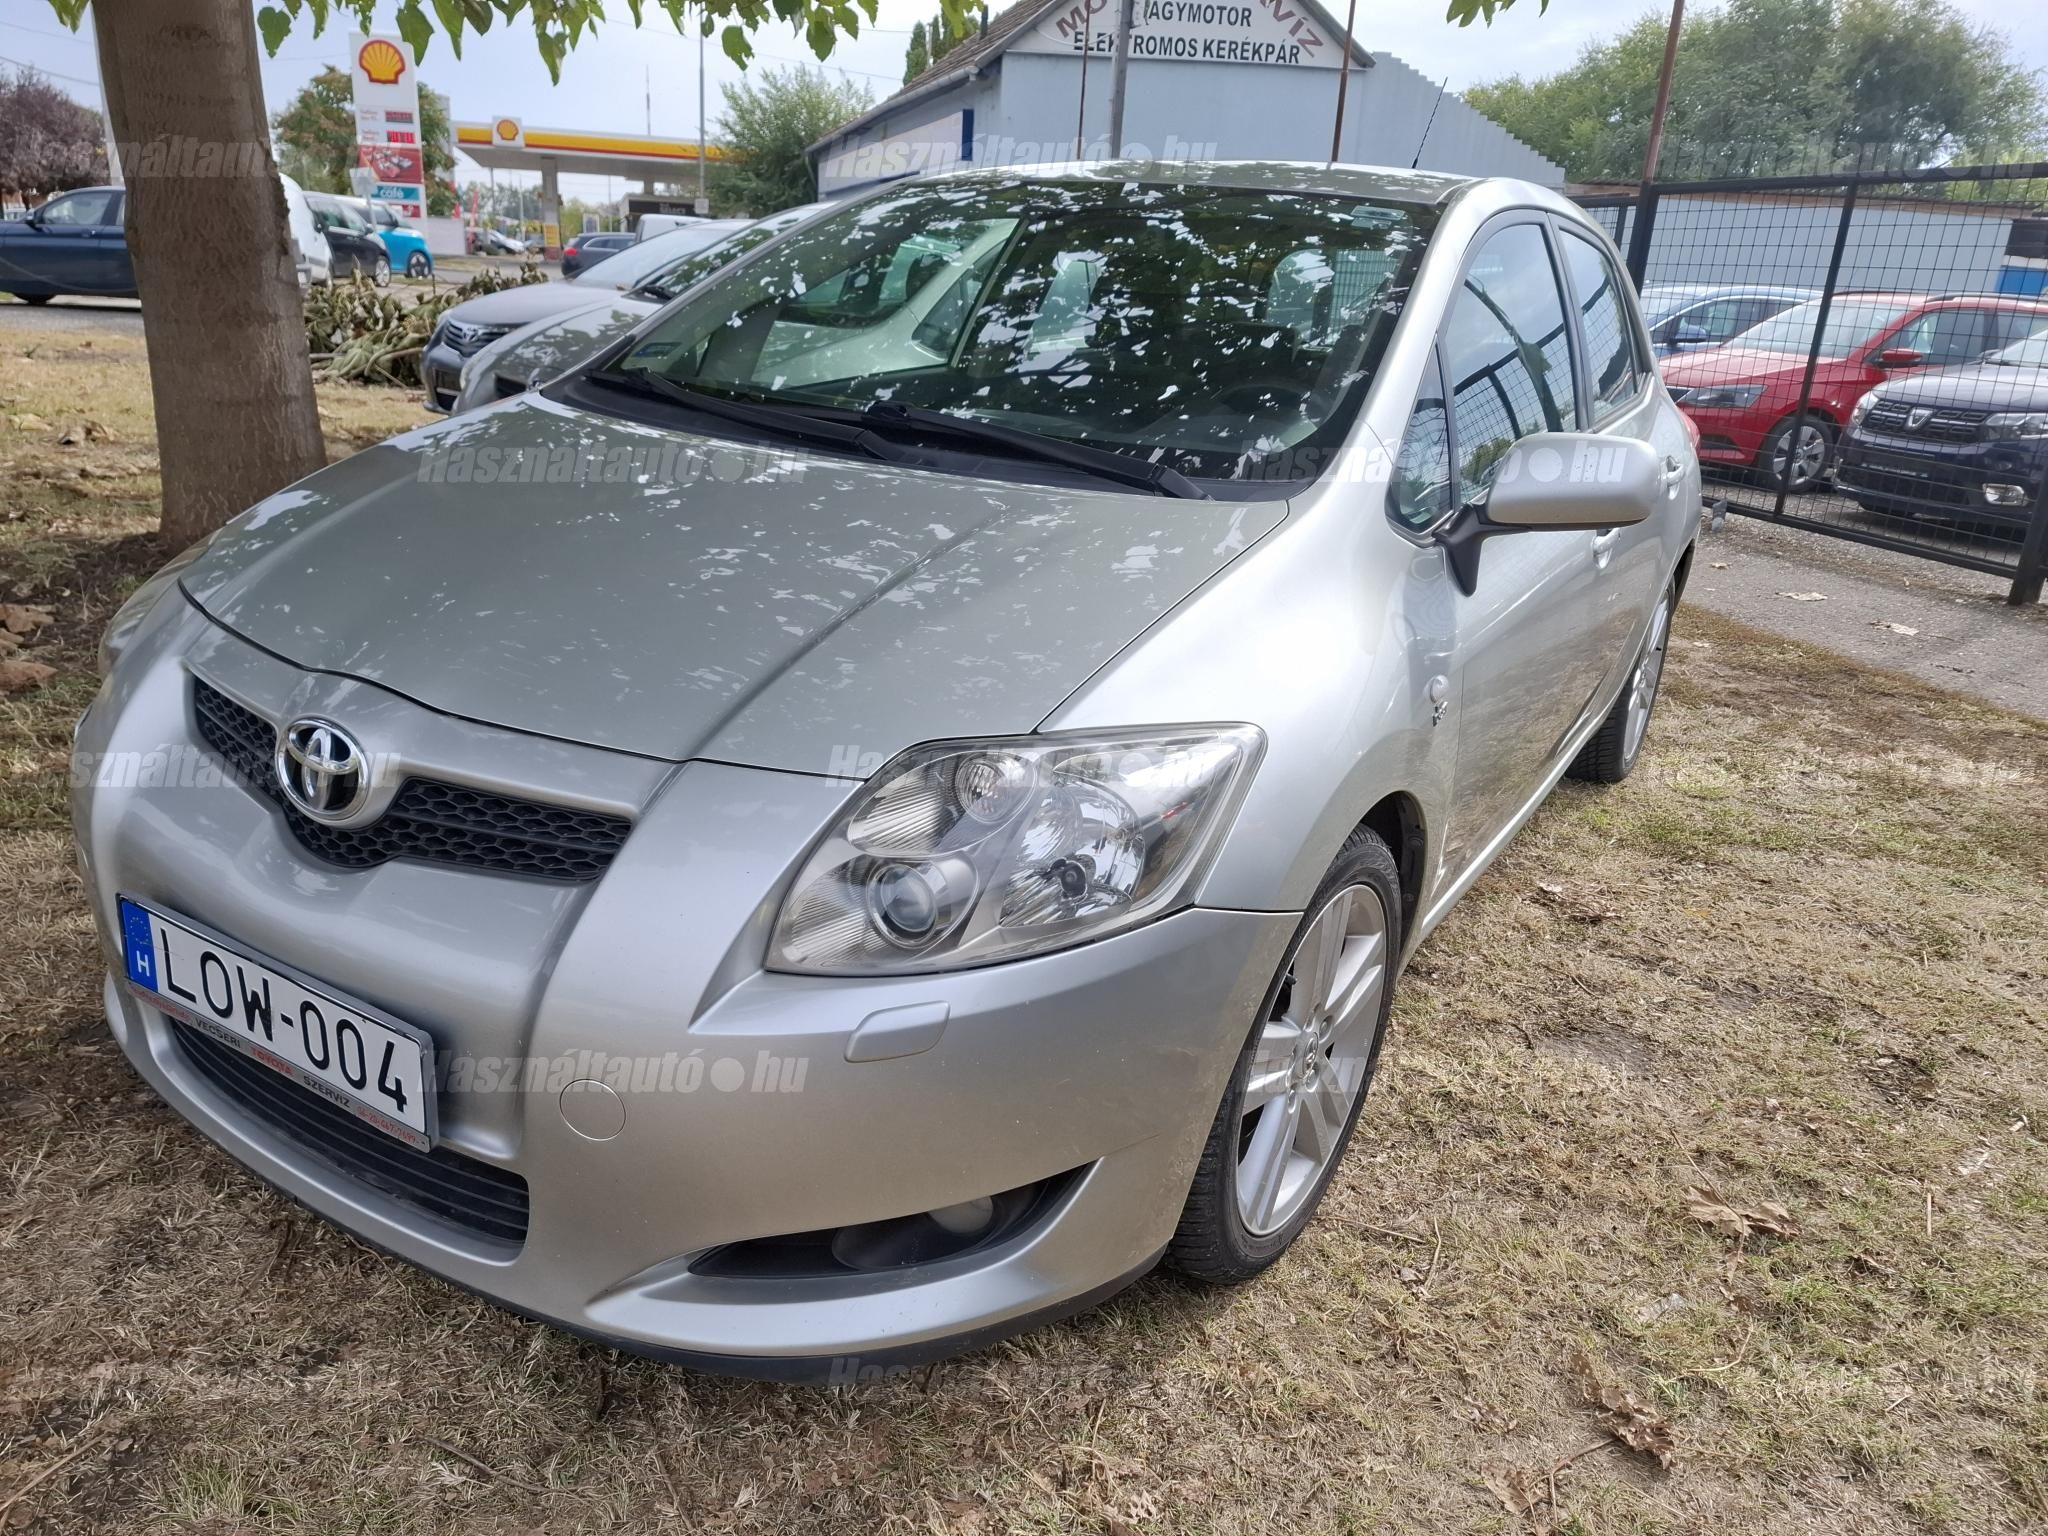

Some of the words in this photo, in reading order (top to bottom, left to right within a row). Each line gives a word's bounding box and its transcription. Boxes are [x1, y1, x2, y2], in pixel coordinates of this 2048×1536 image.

[1143, 0, 1252, 27] AGYMOTOR
[1074, 31, 1198, 57] EEKROMOS
[1203, 37, 1301, 64] KERÉKPÁR
[136, 950, 150, 977] H
[160, 927, 407, 1112] LOW-004
[195, 1017, 241, 1048] VECSERI
[252, 1047, 295, 1076] TOYOTA
[303, 1075, 351, 1108] SZERVIZ
